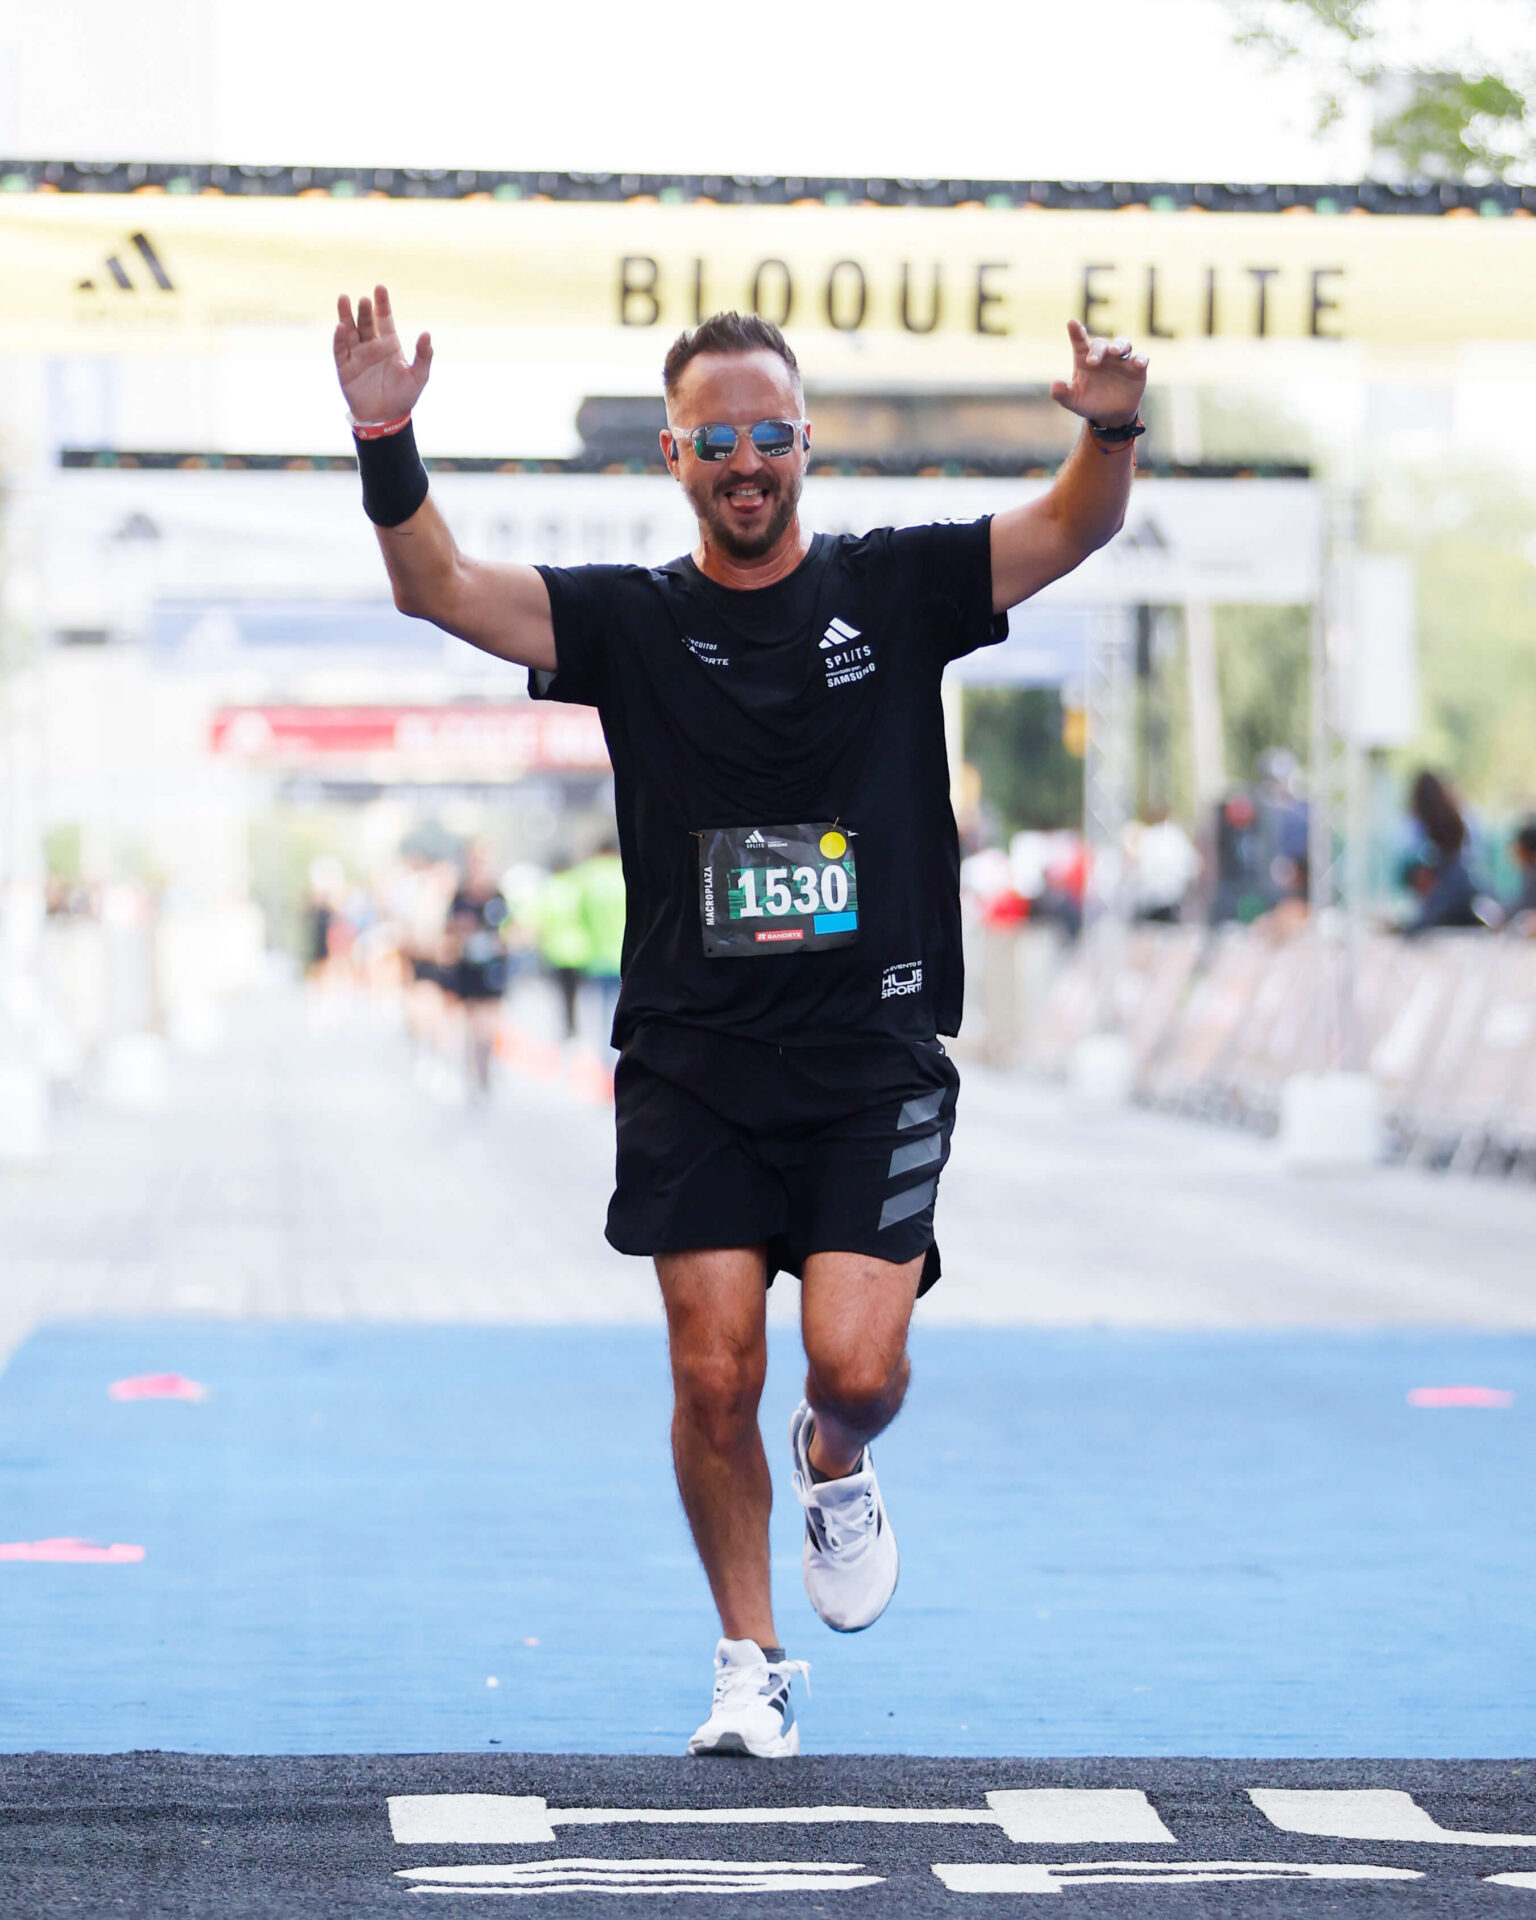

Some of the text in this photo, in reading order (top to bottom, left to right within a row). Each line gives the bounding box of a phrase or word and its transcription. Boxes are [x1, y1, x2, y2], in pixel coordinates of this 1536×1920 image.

[619, 256, 1347, 339] BLOQUE ELITE
[706, 866, 715, 926] MACROPLAZA
[737, 864, 848, 918] 1530
[882, 968, 922, 989] HUB
